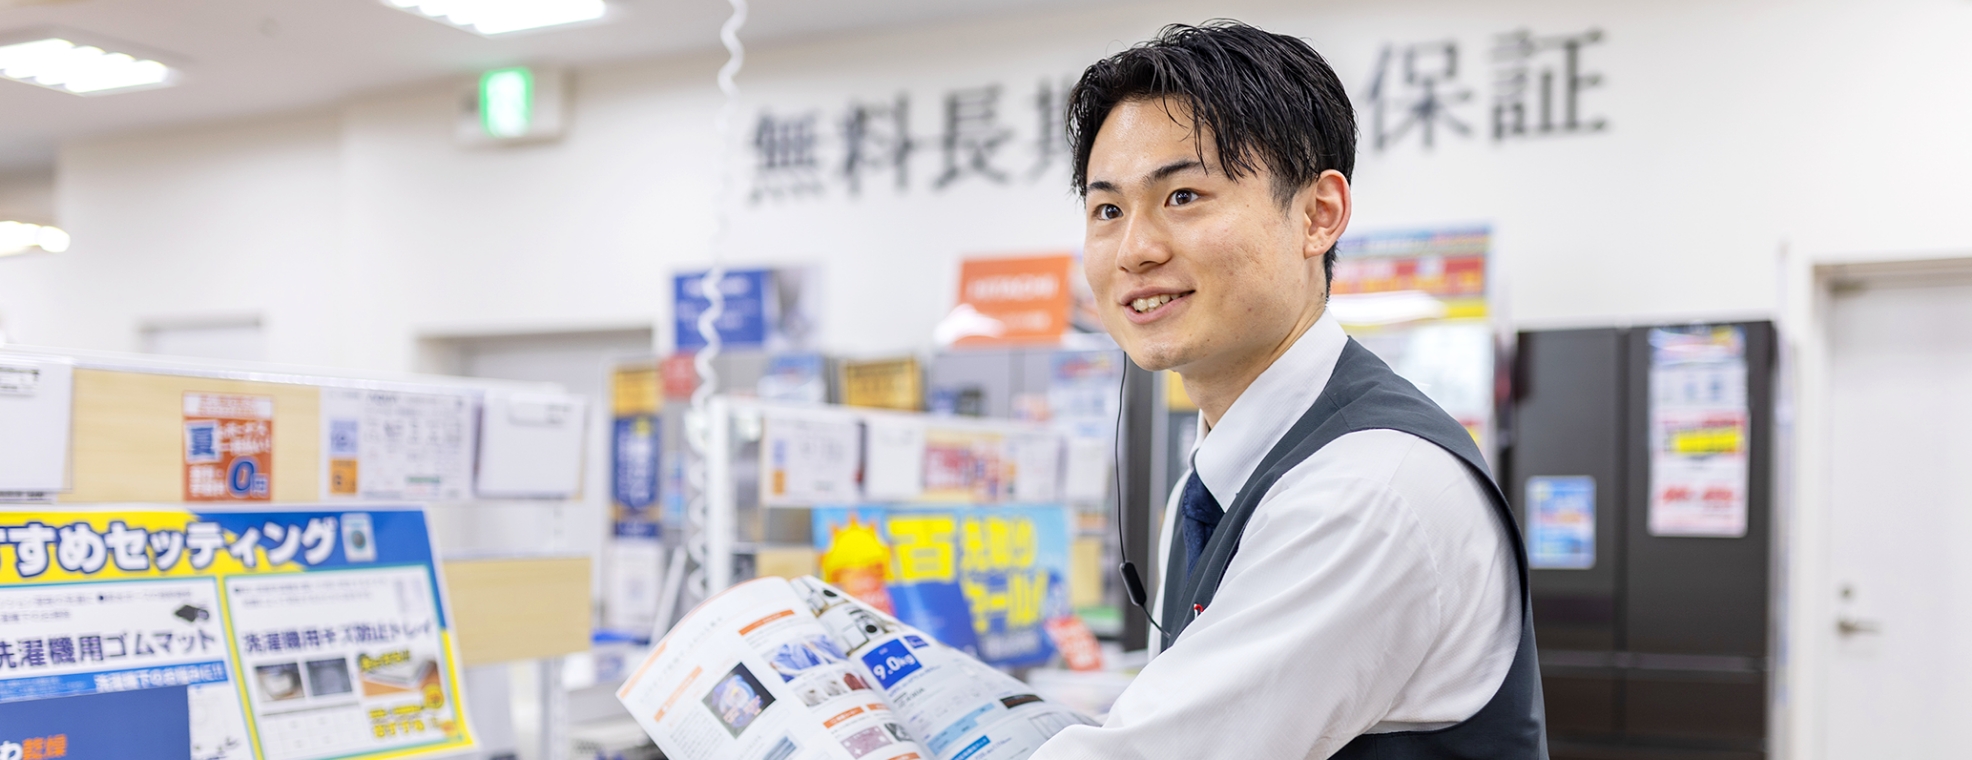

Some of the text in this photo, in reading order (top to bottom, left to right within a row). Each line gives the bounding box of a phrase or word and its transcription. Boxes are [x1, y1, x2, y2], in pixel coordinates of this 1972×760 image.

[1360, 28, 1608, 151] 保証
[0, 515, 338, 577] すめセッティング
